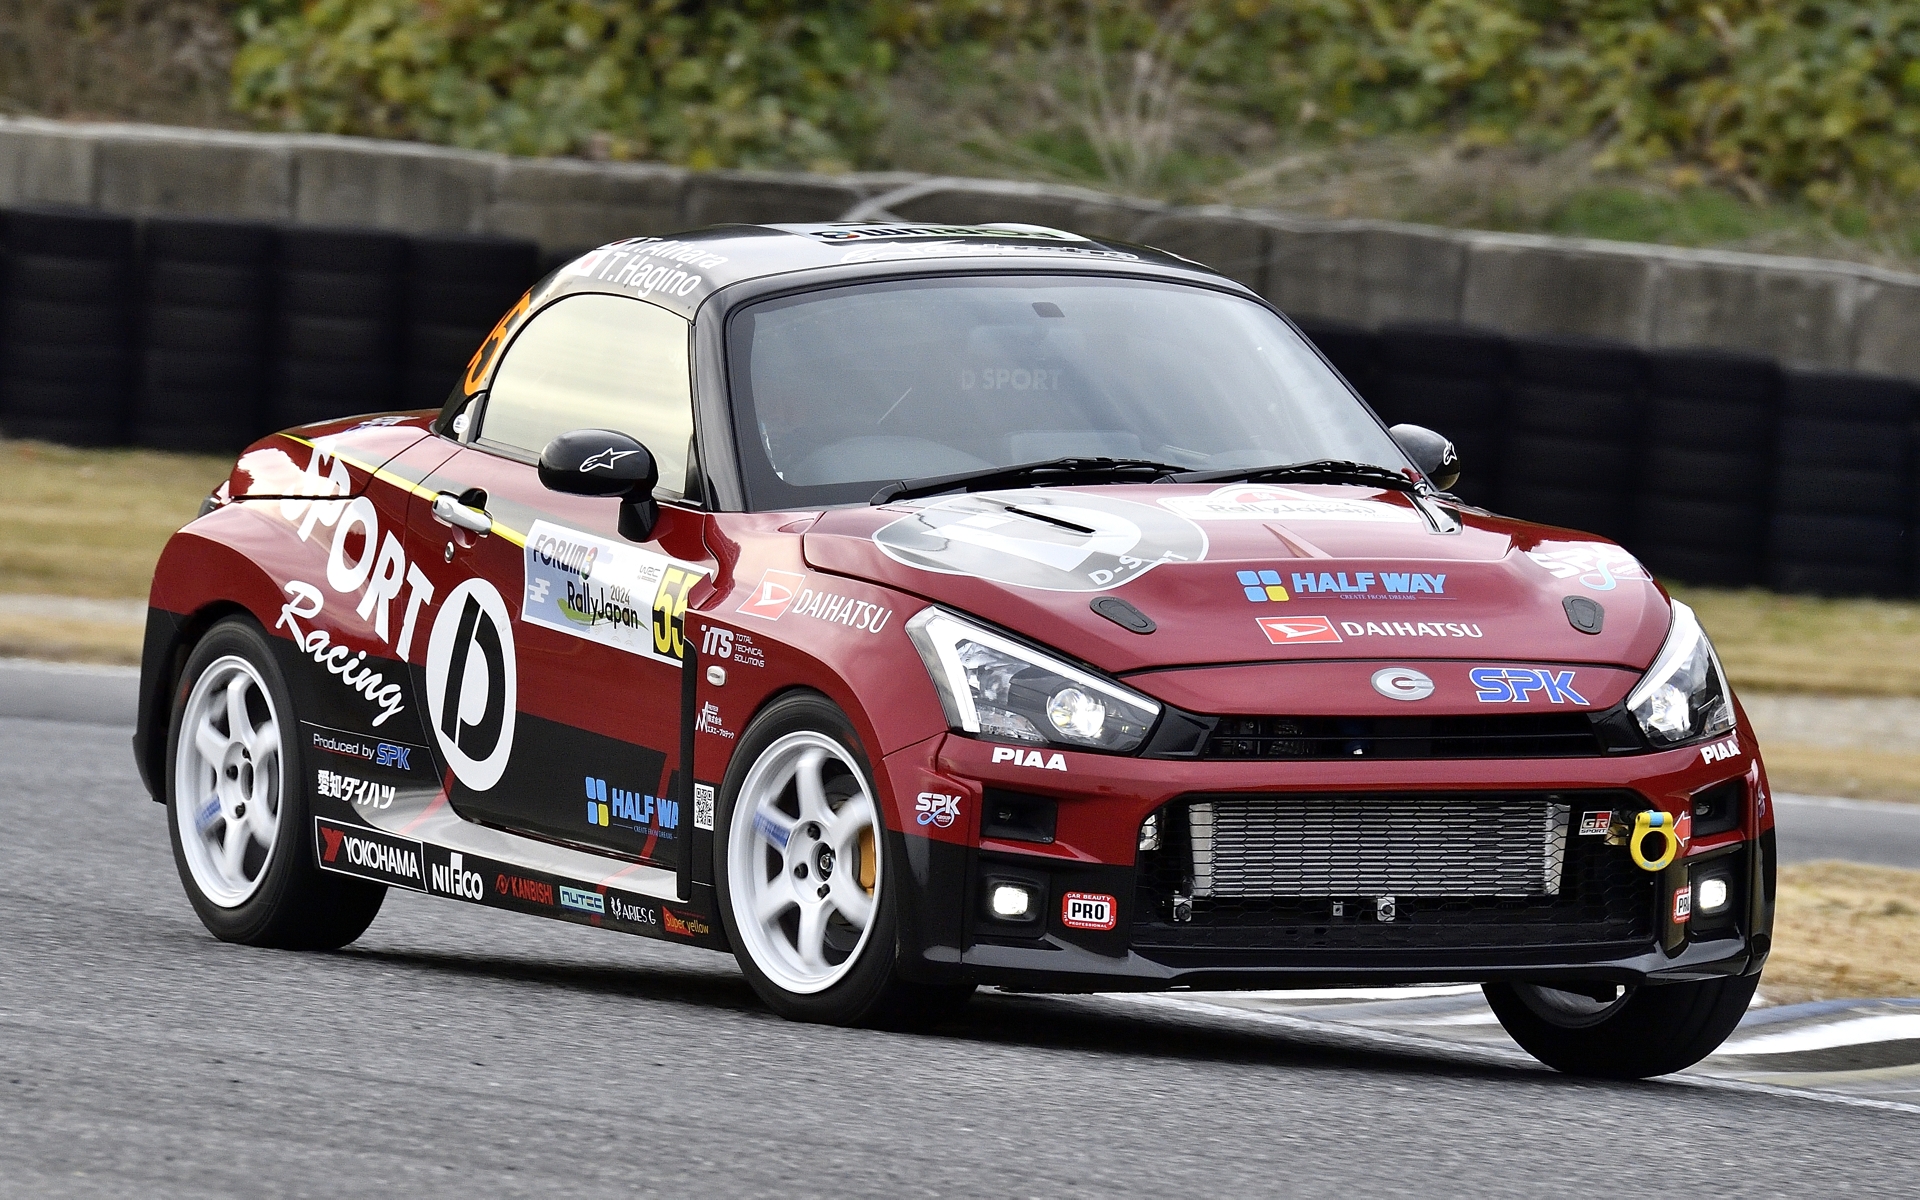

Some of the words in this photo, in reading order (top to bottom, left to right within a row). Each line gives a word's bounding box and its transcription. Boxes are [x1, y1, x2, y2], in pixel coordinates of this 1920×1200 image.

[597, 251, 702, 298] T.Hagino
[961, 369, 976, 390] D
[982, 368, 1065, 390] SPORT
[533, 534, 598, 580] FORUM8
[610, 584, 631, 605] 2024
[1291, 572, 1376, 593] HALF
[1379, 573, 1447, 594] WAY
[652, 565, 708, 659] 55
[792, 588, 893, 634] DAIHATSU
[735, 633, 753, 645] TOTAL
[1341, 620, 1483, 639] DAIHATSU
[275, 579, 405, 728] Racing
[734, 643, 765, 657] TECHNICAL
[734, 653, 766, 668] SOLUTIONS
[1469, 667, 1590, 706] SPK
[313, 733, 360, 755] Produced
[361, 749, 375, 761] by
[376, 742, 411, 771] SPK
[991, 746, 1068, 771] PIAA
[1700, 740, 1741, 765] PIAA
[317, 769, 396, 810] 愛知ダイハツ
[611, 787, 654, 824] HALF
[656, 797, 679, 829] WA
[915, 792, 962, 815] SPK
[1582, 818, 1608, 828] GR
[343, 835, 421, 880] YOKOHAMA
[511, 875, 554, 906] KANBISHI
[1082, 894, 1111, 902] BEAUTY
[622, 904, 648, 924] ARIES
[648, 909, 657, 925] G
[1071, 902, 1105, 920] PRO
[686, 919, 710, 934] yellow
